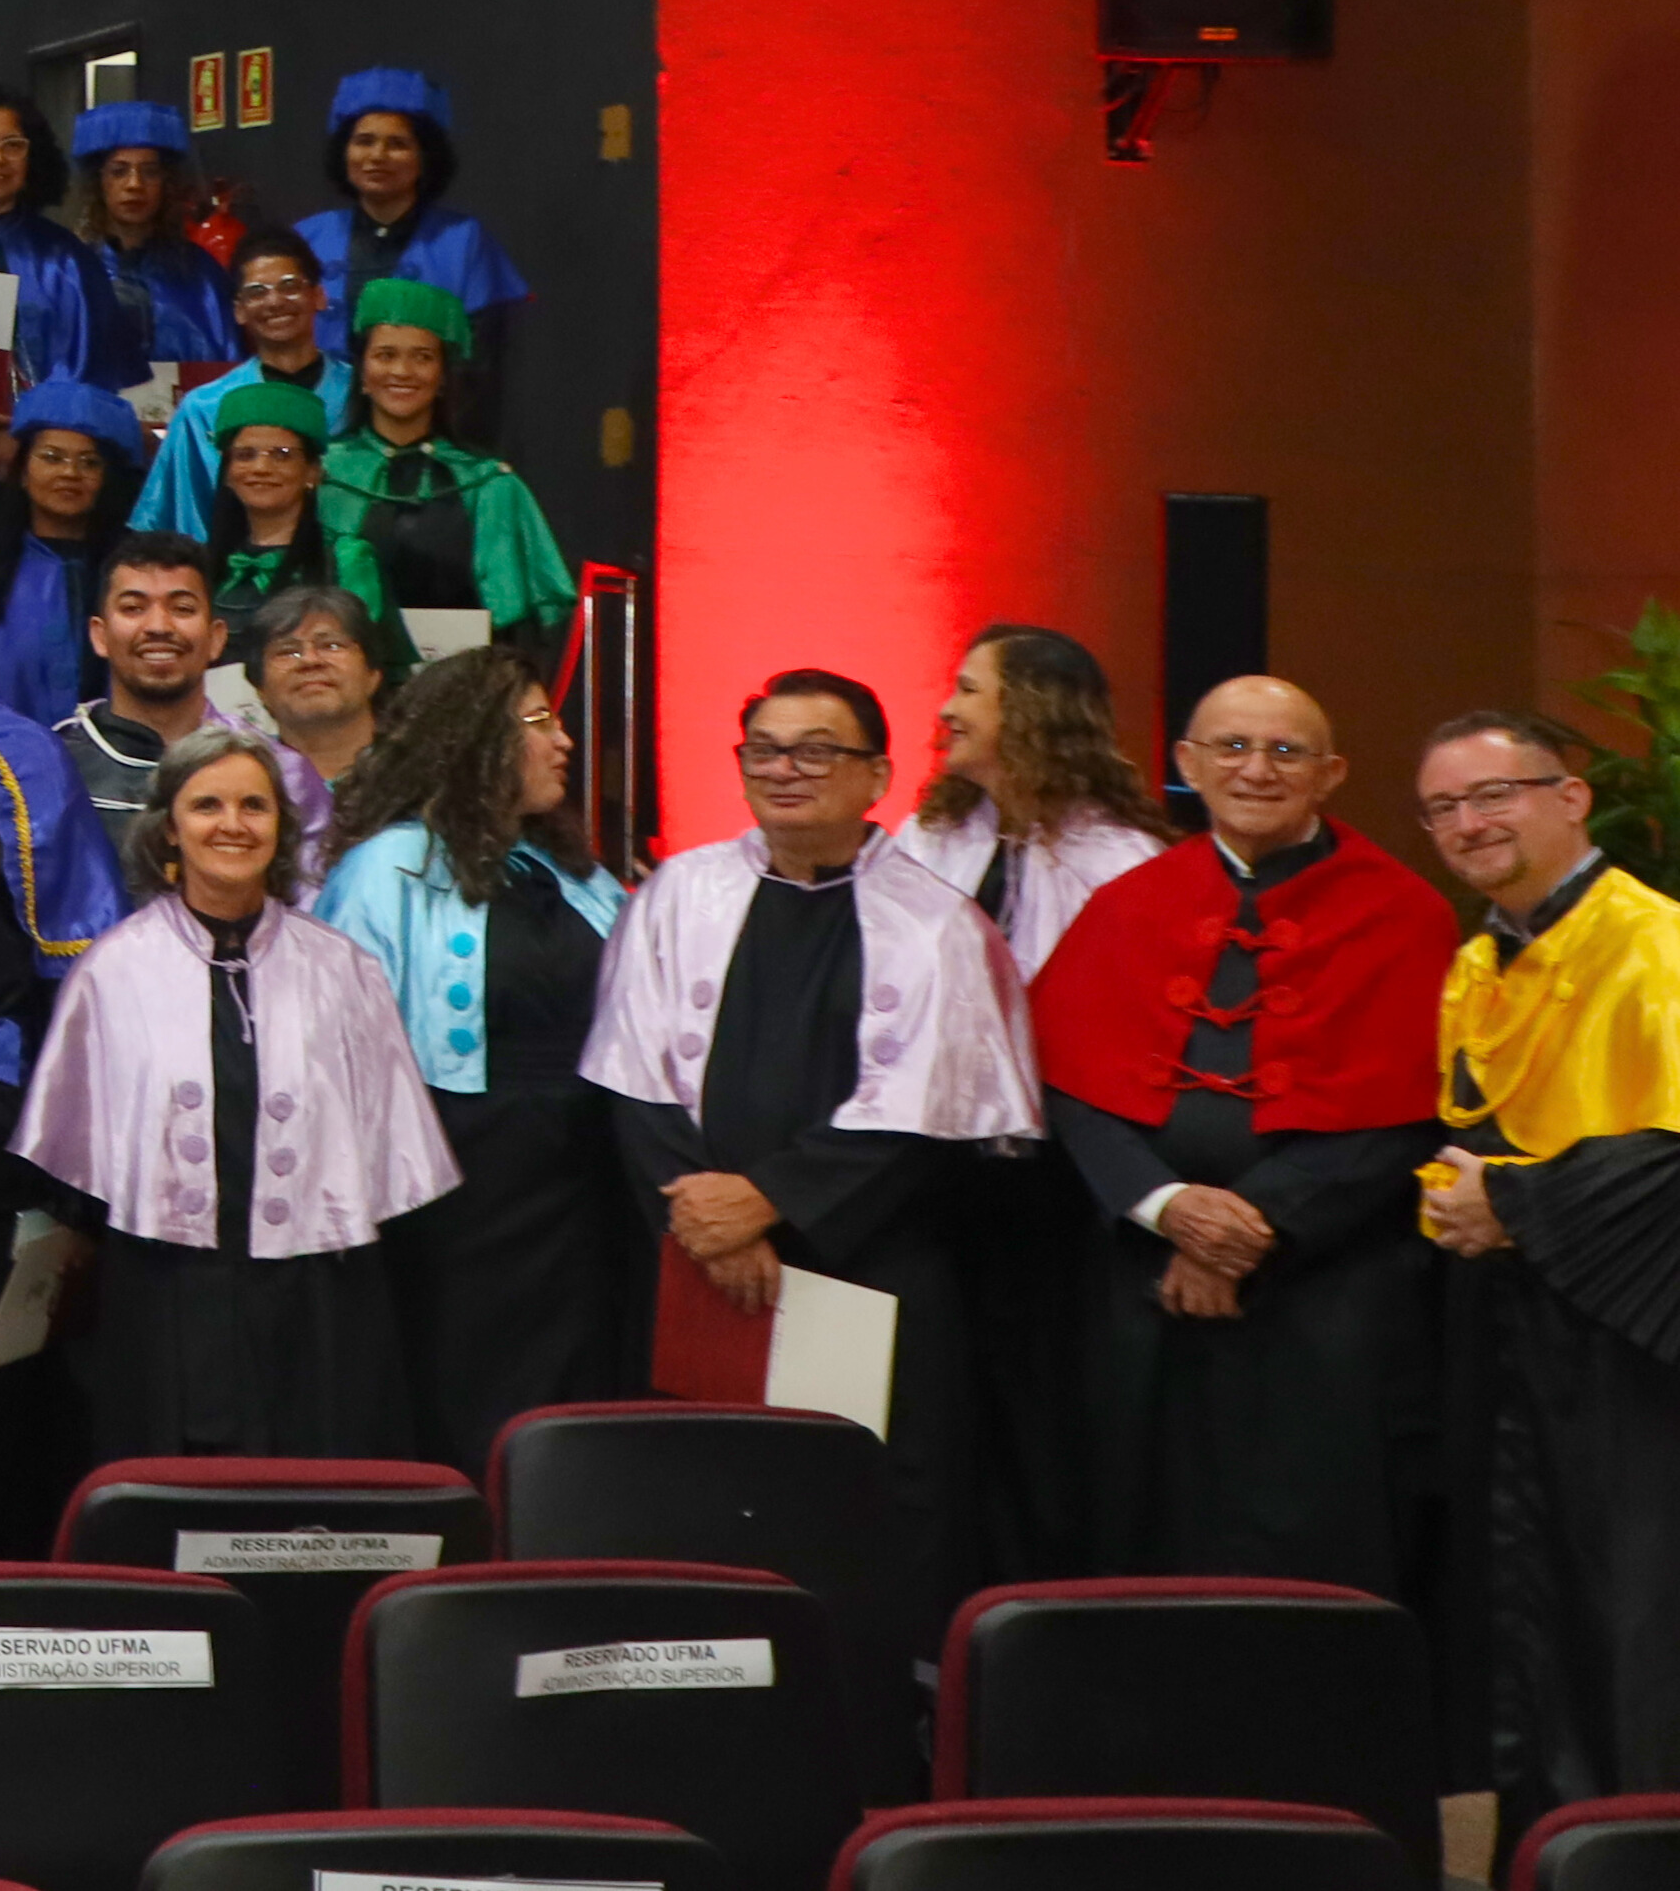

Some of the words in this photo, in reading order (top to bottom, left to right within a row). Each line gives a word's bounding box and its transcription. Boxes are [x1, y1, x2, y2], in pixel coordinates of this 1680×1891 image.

[231, 1538, 336, 1552] RESERVADO
[341, 1538, 389, 1551] UFMA
[97, 1639, 151, 1655] UFMA
[563, 1646, 658, 1668] RESERVADO
[664, 1645, 717, 1662] UFMA
[94, 1662, 182, 1678] SUPERIOR
[661, 1665, 745, 1684] SUPERIOR
